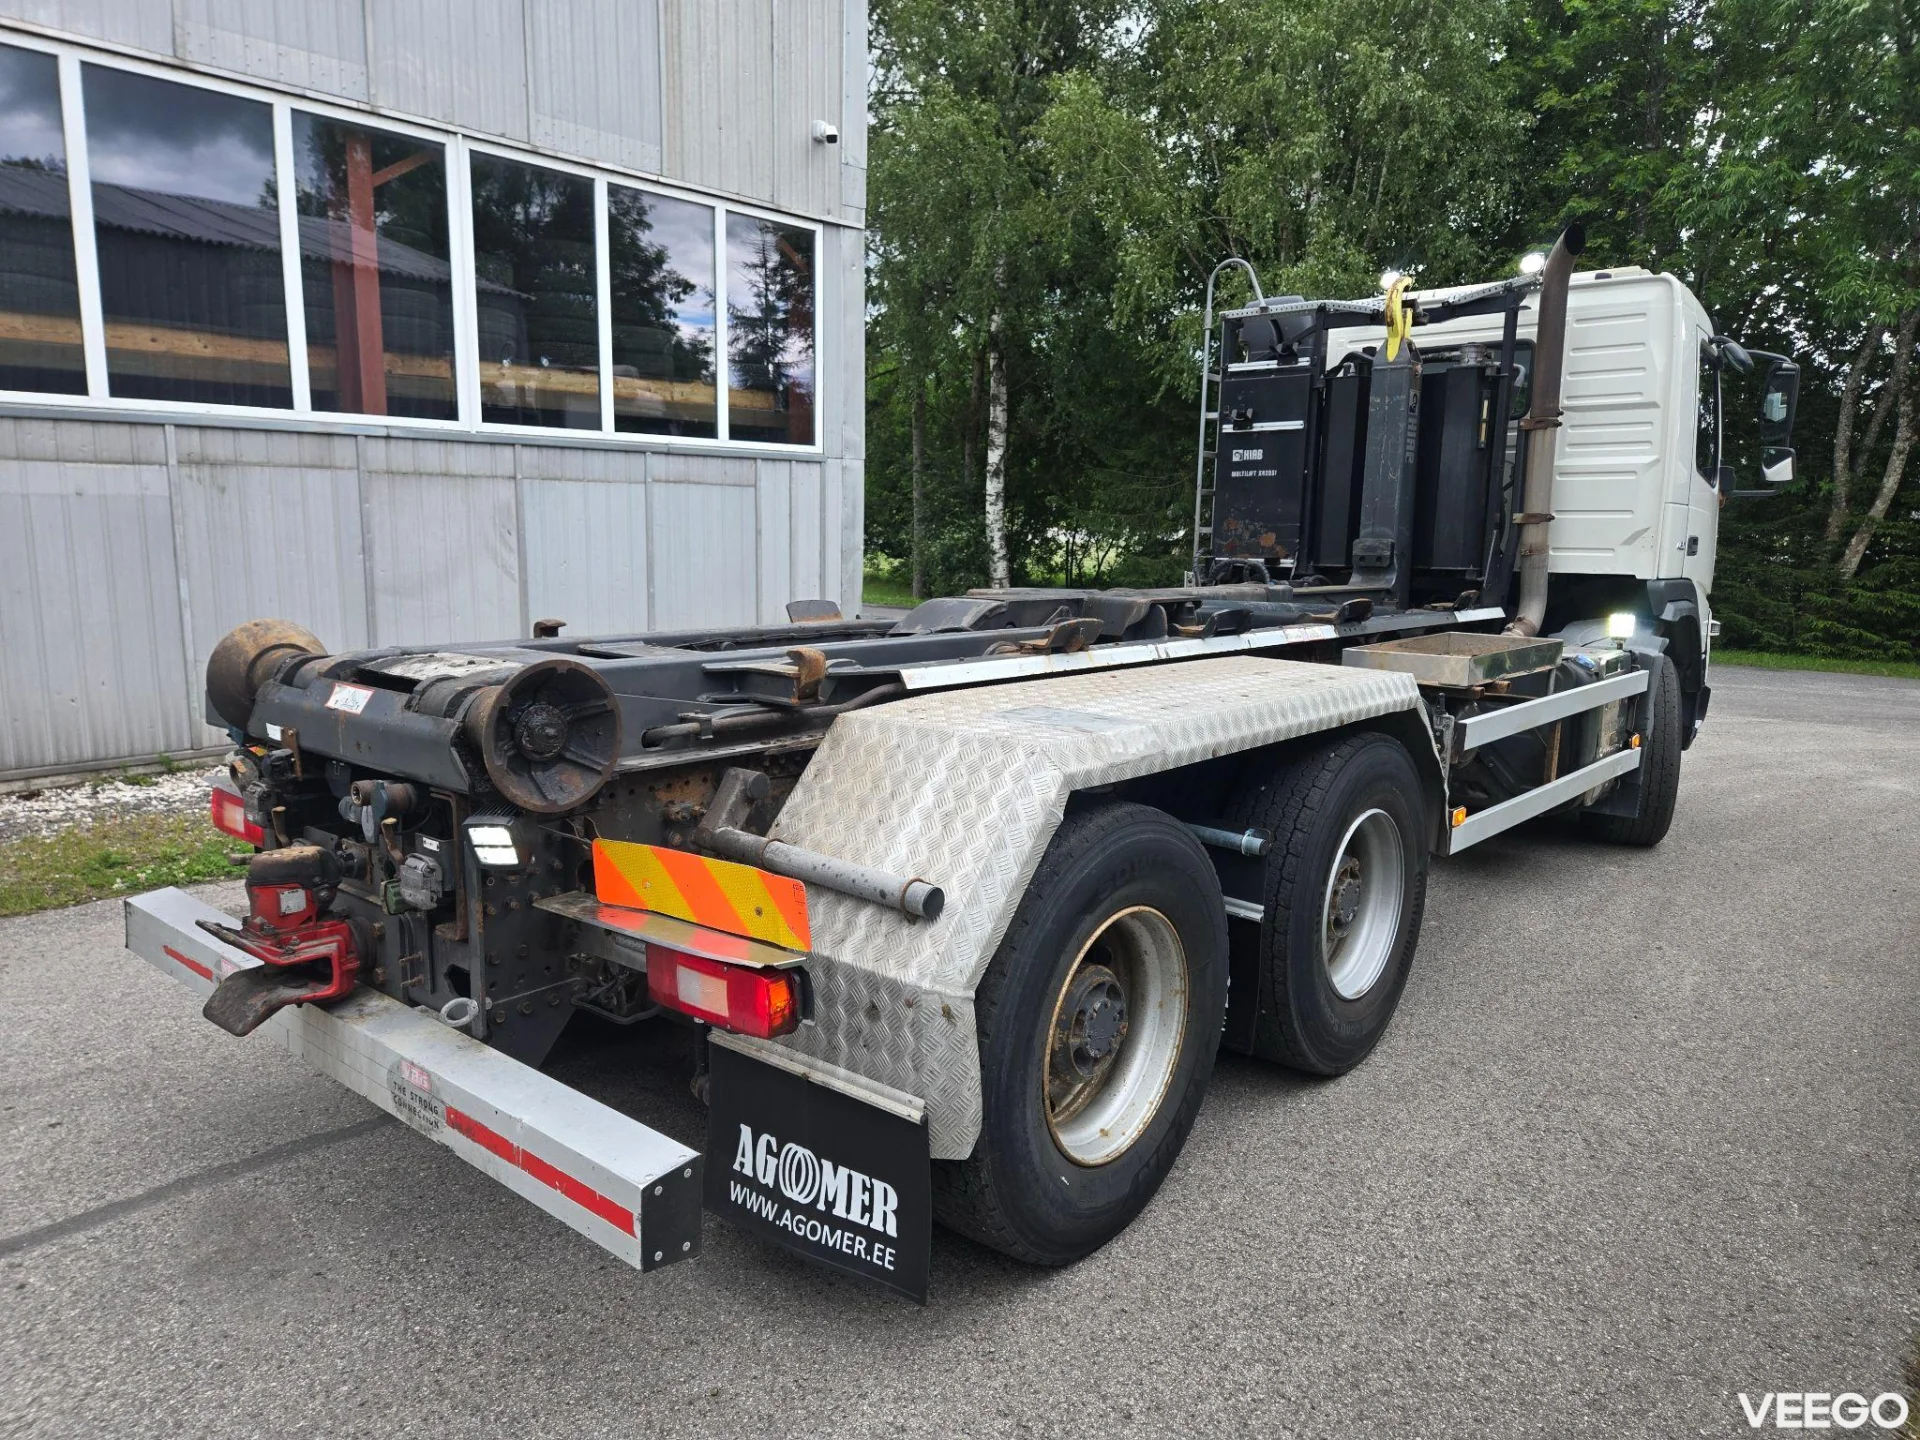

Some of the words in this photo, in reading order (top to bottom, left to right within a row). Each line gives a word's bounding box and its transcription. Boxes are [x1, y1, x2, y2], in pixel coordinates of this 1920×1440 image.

[1244, 449, 1263, 460] HIAB
[393, 1081, 407, 1096] THE
[410, 1091, 439, 1115] STRONG
[393, 1095, 440, 1129] CONNECTION
[732, 1123, 898, 1238] AGOMER
[730, 1180, 896, 1271] WWW.AGOMER.EE
